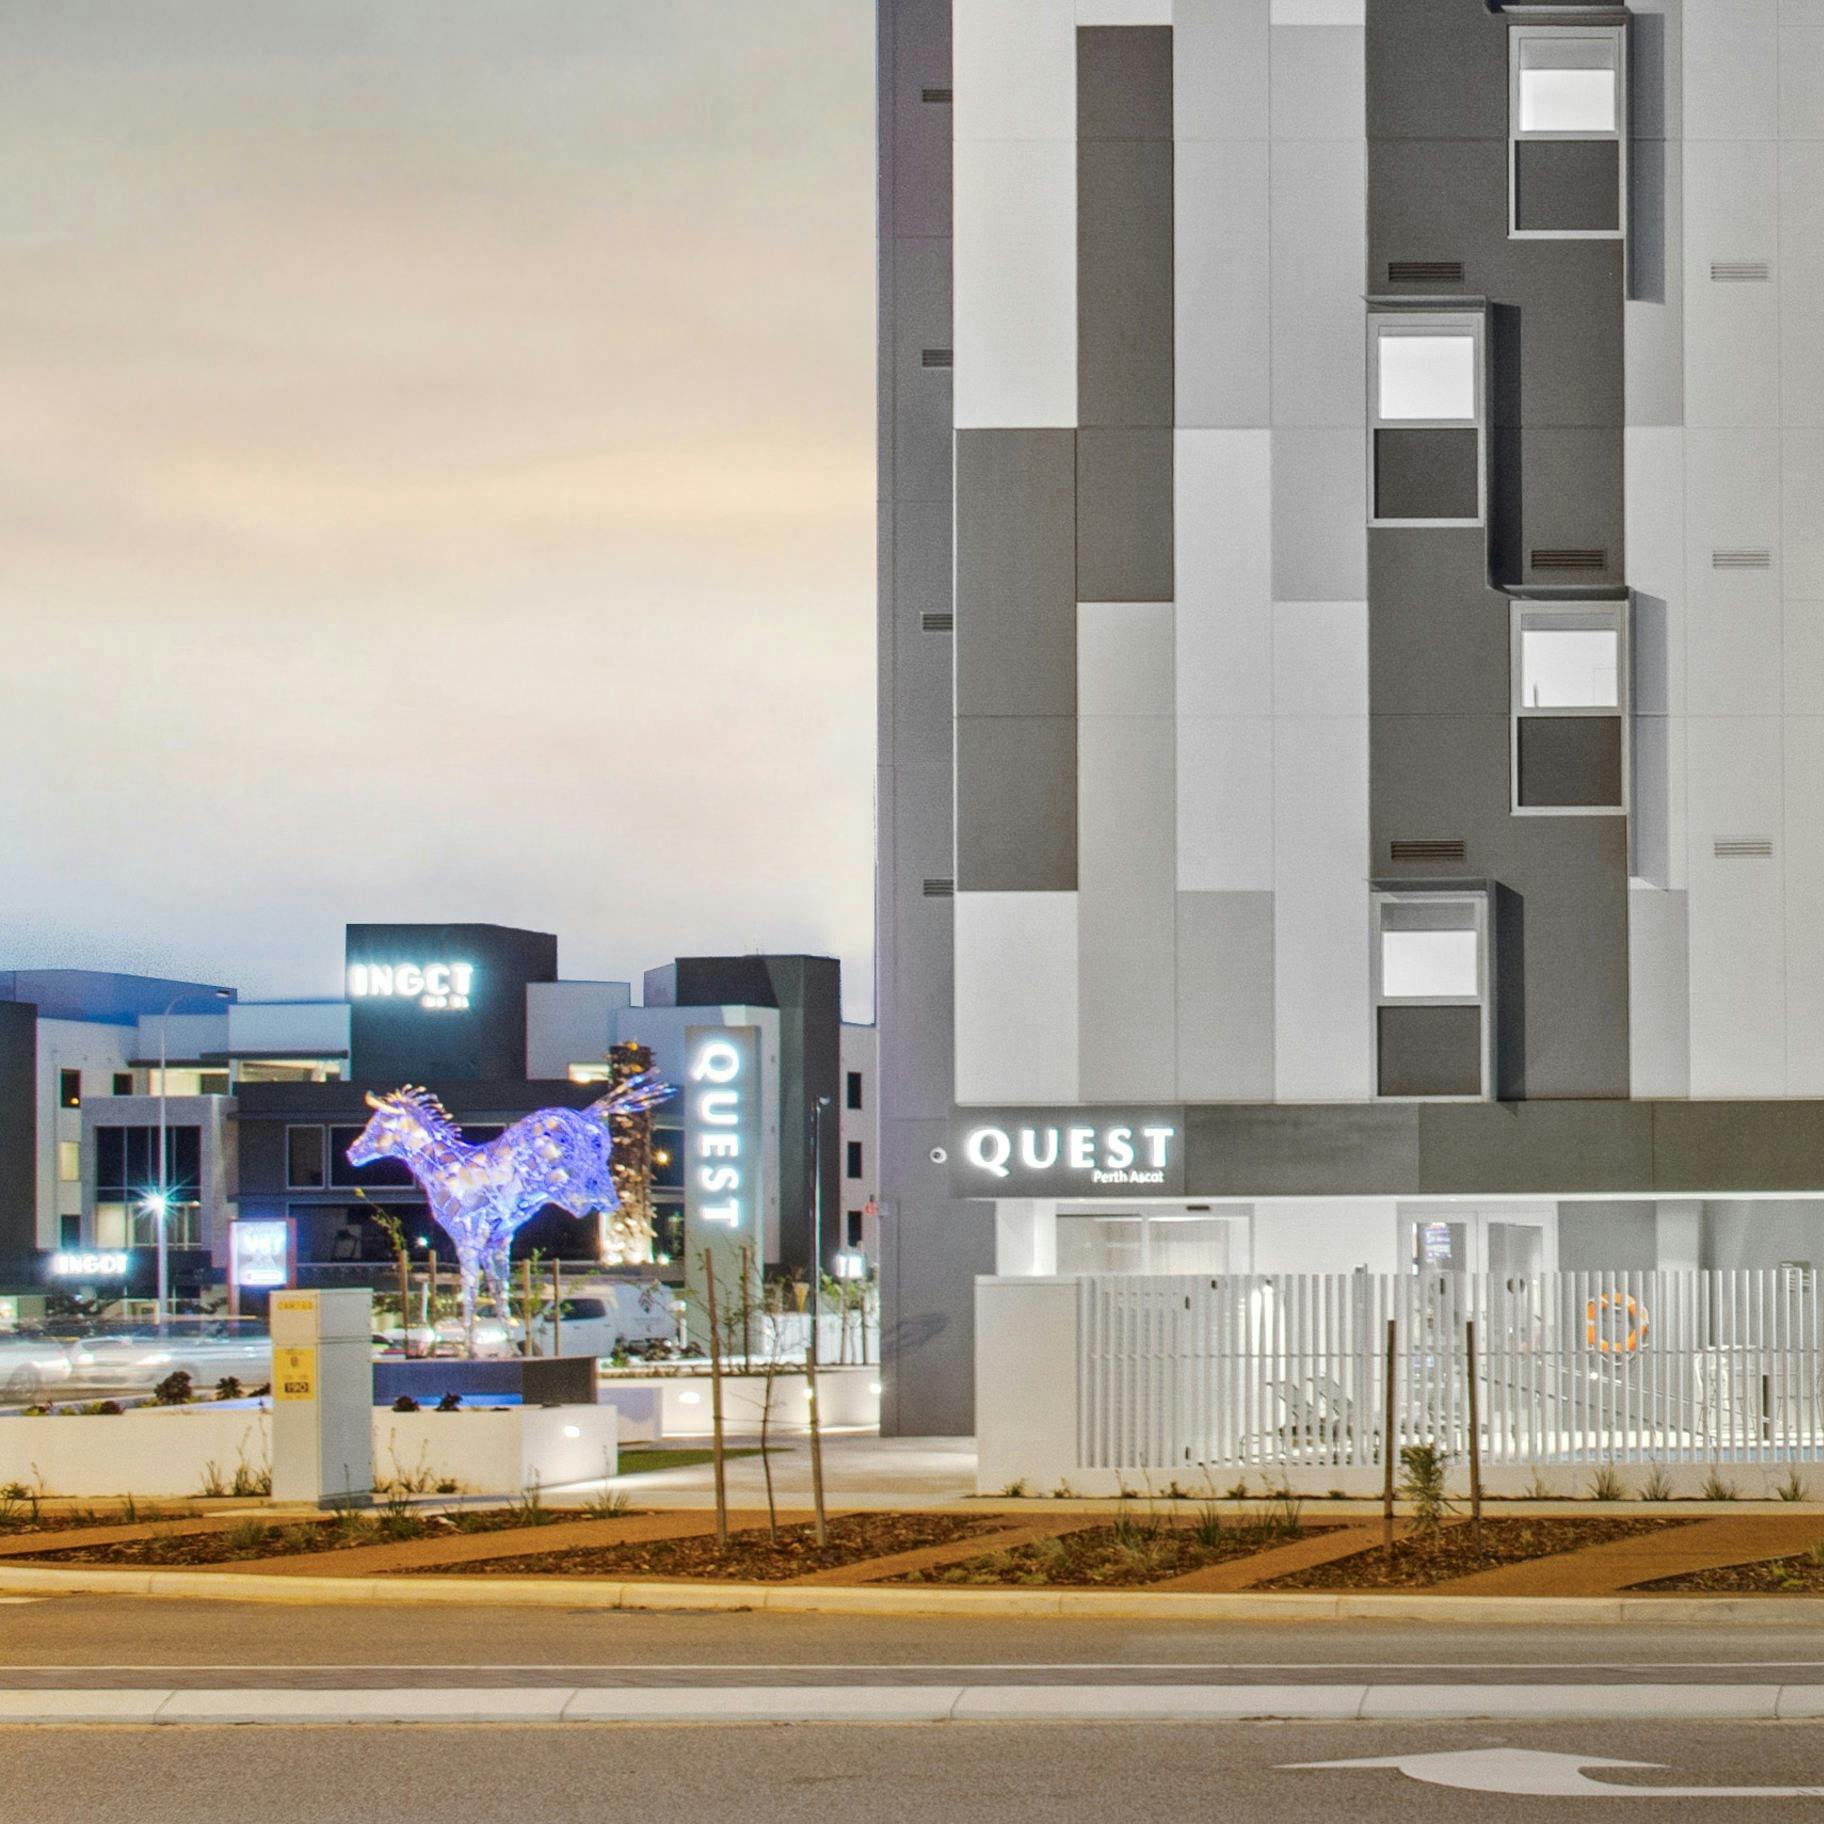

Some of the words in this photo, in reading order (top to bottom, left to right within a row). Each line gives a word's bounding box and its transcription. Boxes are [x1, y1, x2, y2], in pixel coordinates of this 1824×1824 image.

[692, 1040, 740, 1228] QUEST
[968, 1128, 1174, 1178] QUEST
[1093, 1169, 1128, 1183] Perth
[1129, 1169, 1164, 1183] Ascot
